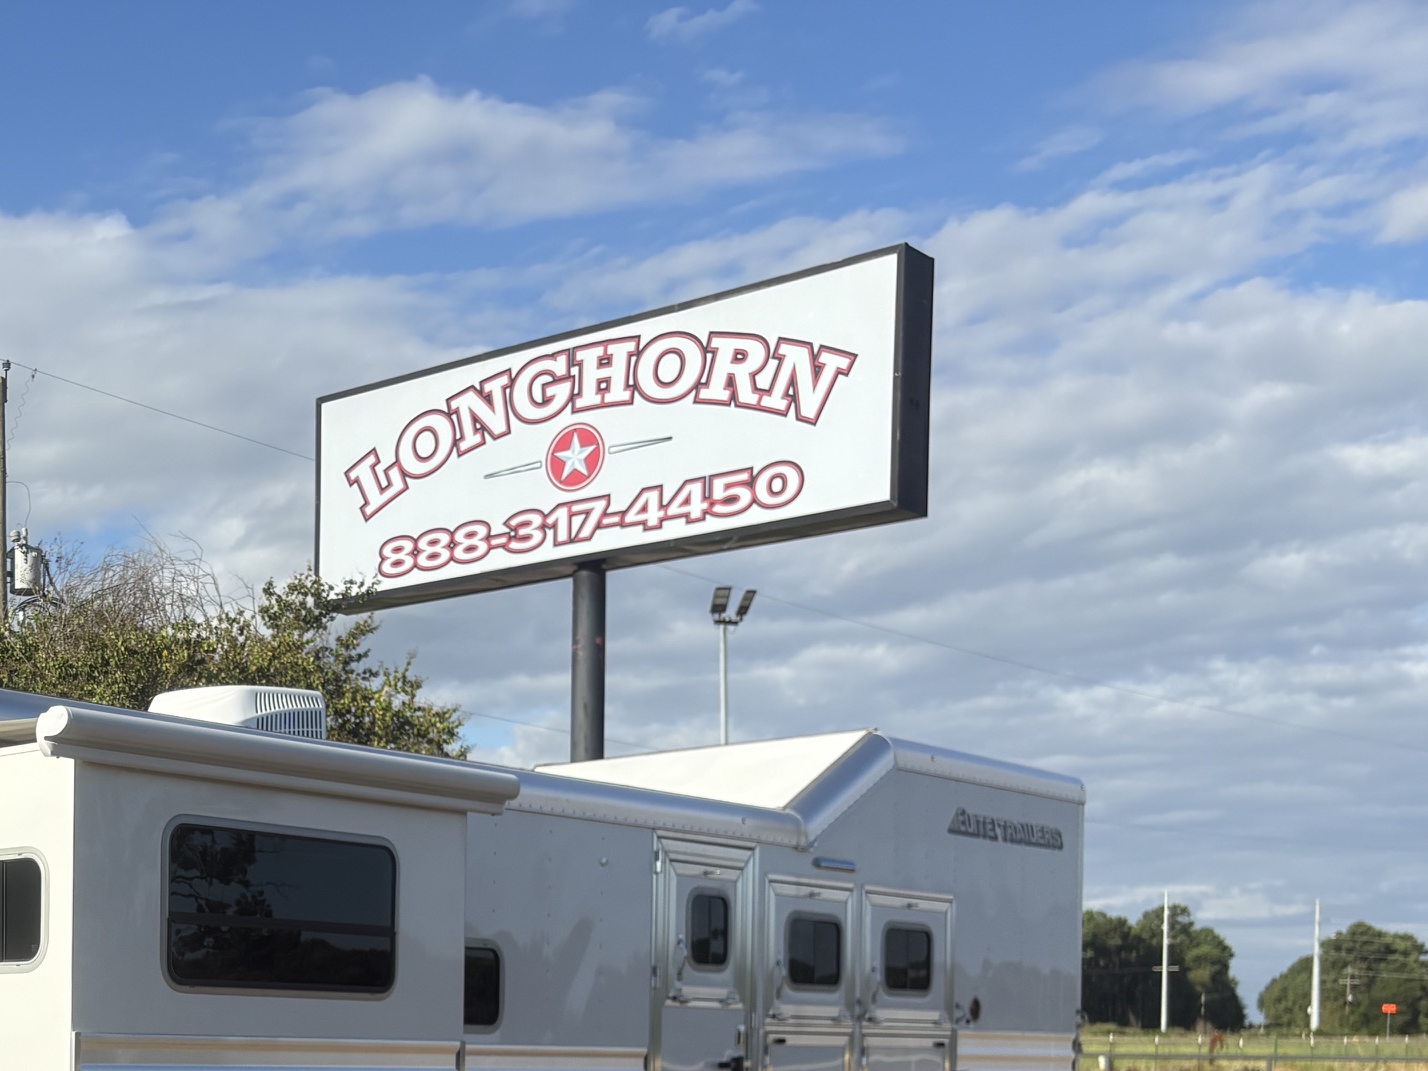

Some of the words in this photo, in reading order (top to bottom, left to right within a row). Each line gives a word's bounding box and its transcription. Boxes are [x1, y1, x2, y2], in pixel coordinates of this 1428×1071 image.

[345, 331, 858, 522] LONGHORN
[378, 461, 805, 578] 888-317-4450
[995, 818, 1064, 851] TRAILERS
